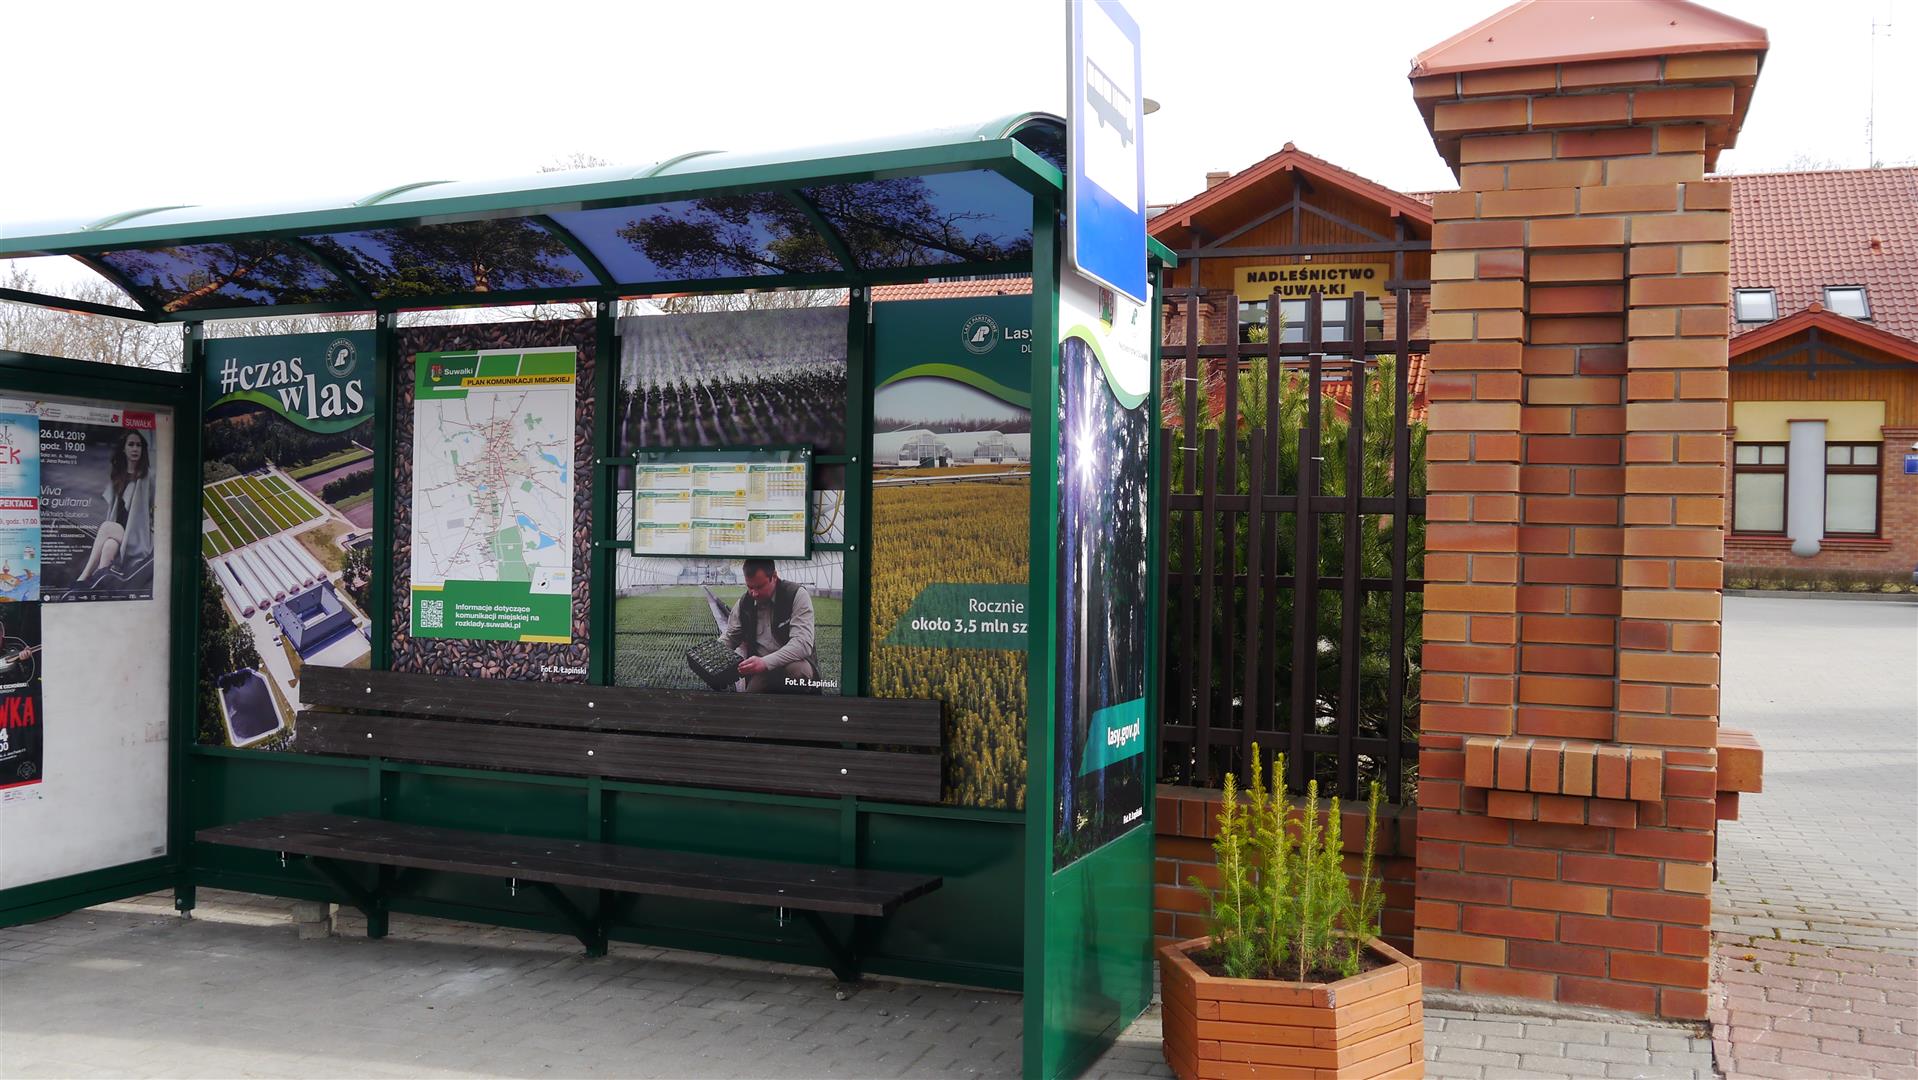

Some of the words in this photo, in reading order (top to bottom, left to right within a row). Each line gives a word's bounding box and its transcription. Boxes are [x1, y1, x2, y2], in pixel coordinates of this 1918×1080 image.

[1247, 267, 1375, 283] NADLEŚNICTWO
[1273, 284, 1346, 295] SUWAŁKI
[220, 357, 304, 394] #czas
[467, 378, 485, 386] PLAN
[486, 377, 533, 385] KOMUNIKACJI
[534, 376, 570, 384] MIEJSKIEJ
[40, 429, 86, 441] 26.04.2019
[65, 442, 86, 452] 19.00
[40, 485, 61, 496] Viva
[455, 604, 493, 612] Informacje
[494, 605, 531, 613] dotyczące
[969, 598, 1024, 613] Rocznie
[455, 612, 497, 620] komunikacji
[911, 617, 951, 632] około
[954, 619, 977, 634] 3,5
[981, 618, 1009, 633] mln
[1012, 622, 1028, 634] sz
[785, 678, 798, 686] Fot.
[808, 679, 838, 688] Łapiński
[1107, 717, 1141, 746] lasy.gov.pl
